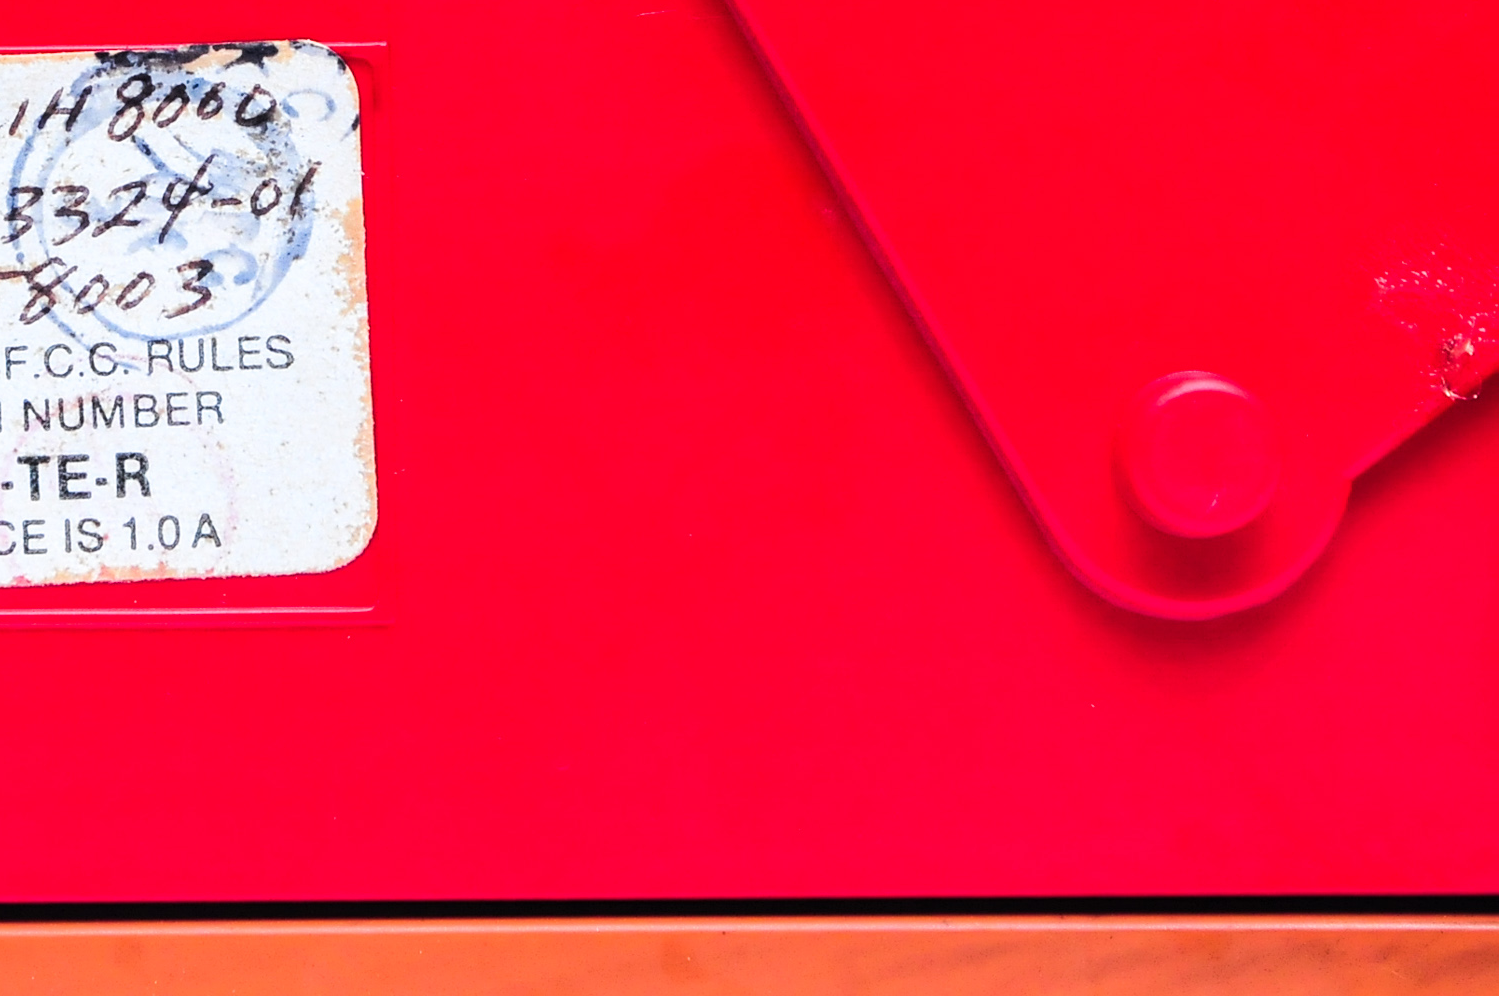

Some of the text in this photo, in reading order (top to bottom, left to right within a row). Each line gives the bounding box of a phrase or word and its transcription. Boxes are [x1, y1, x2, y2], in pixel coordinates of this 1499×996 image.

[147, 334, 296, 374] RULES
[23, 391, 224, 432] NUMBER
[64, 518, 105, 554] IS
[123, 514, 181, 551] 1.0
[192, 512, 222, 549] A
